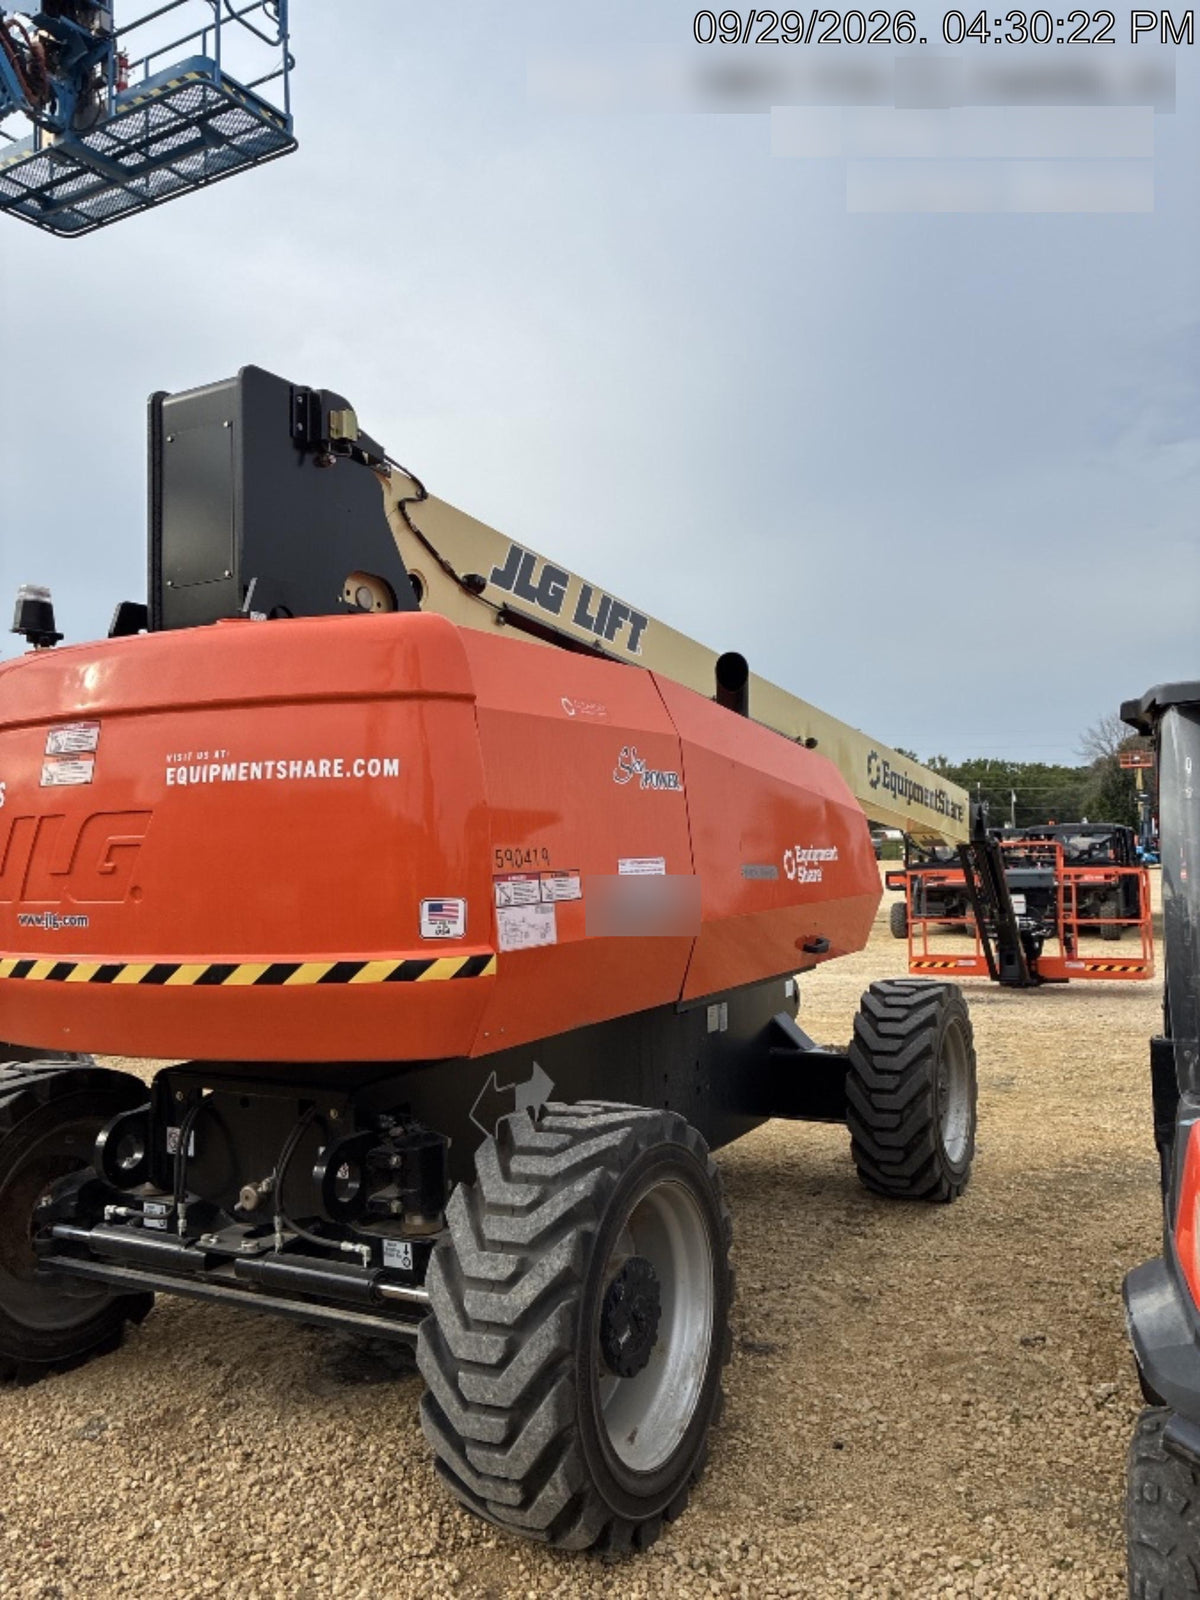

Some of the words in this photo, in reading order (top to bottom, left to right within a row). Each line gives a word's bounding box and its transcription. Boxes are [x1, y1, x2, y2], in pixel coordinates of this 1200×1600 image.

[489, 542, 570, 617] JLG
[571, 583, 650, 656] LIFT
[166, 752, 192, 763] VISIT
[196, 751, 209, 761] US
[166, 758, 400, 786] EQUIPMENTSHARE.COM
[881, 760, 964, 823] EquipmentShare
[795, 845, 839, 866] Equipment
[798, 866, 822, 883] Share
[18, 912, 88, 930] www.jlg.com
